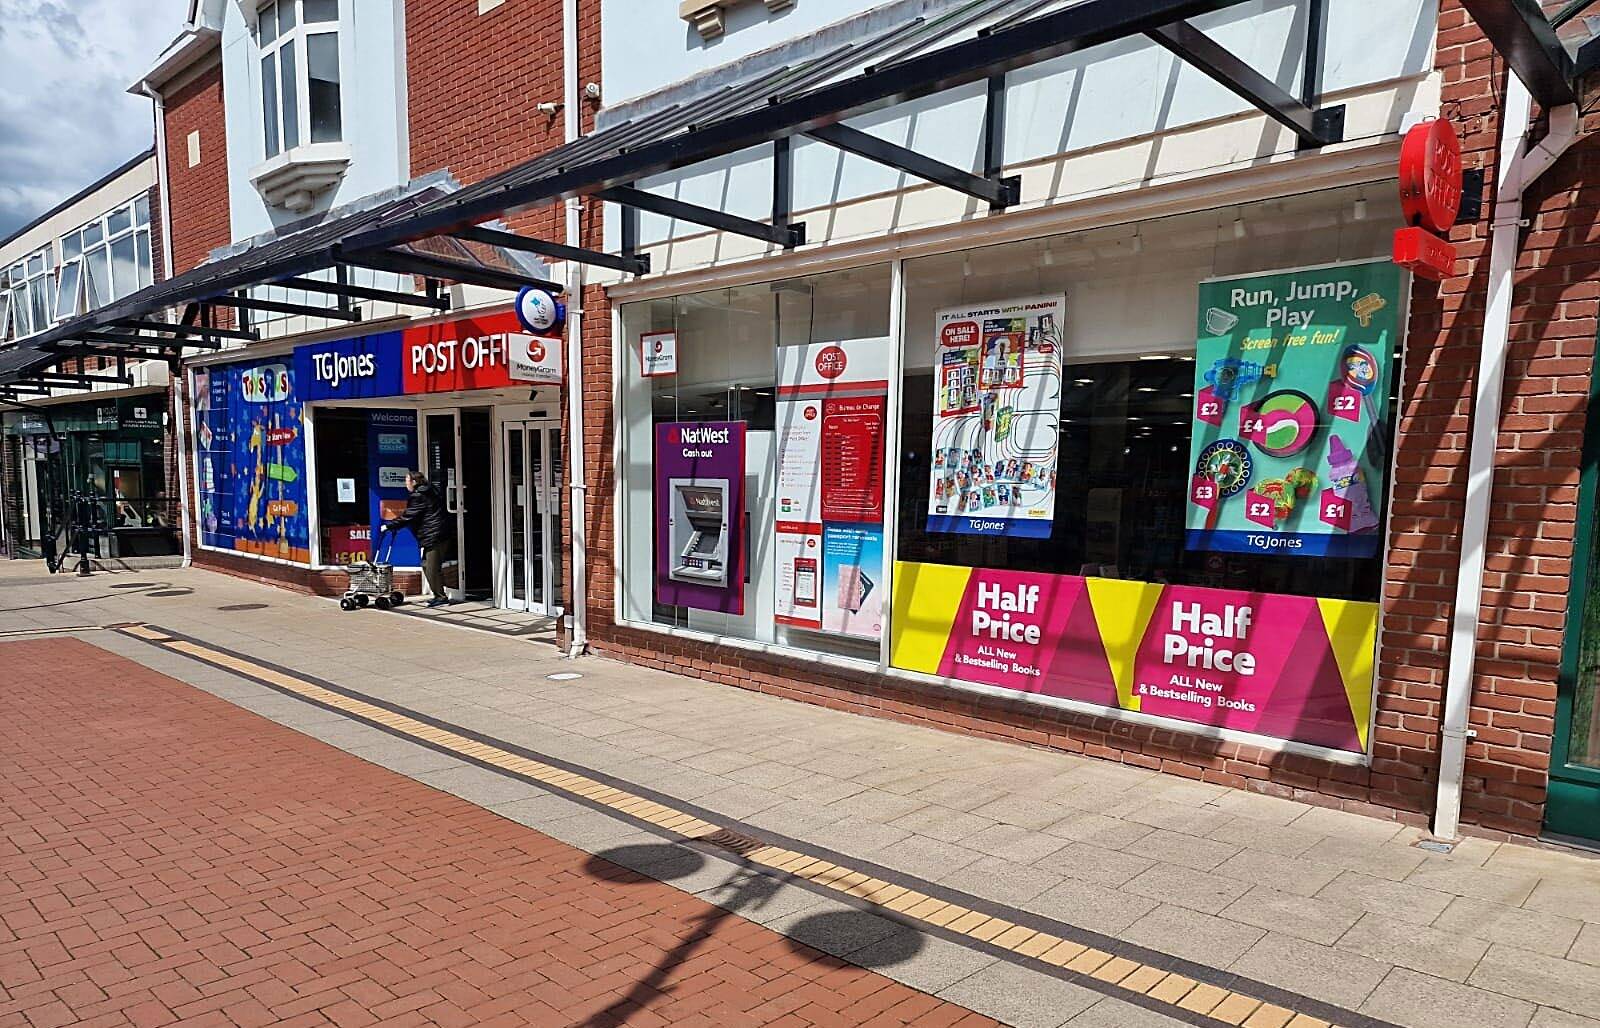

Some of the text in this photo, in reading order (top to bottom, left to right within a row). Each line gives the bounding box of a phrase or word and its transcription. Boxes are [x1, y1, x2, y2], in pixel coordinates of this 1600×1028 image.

[1231, 280, 1358, 307] Run, Jump,
[968, 309, 1000, 317] STARTS
[1266, 306, 1315, 330] Play
[945, 327, 956, 336] ON
[957, 325, 976, 334] SALE
[950, 334, 971, 343] HERE!
[1240, 329, 1340, 350] Screen free fun!
[412, 332, 507, 374] POST OFFI
[822, 352, 841, 362] POST
[312, 352, 374, 387] TGJones
[516, 363, 557, 374] MoneyGram
[818, 362, 844, 371] OFFICE
[862, 403, 880, 411] Change
[1200, 403, 1218, 416] £2
[1333, 396, 1356, 411] £2
[371, 413, 415, 422] Welcome
[1243, 419, 1264, 433] £4
[681, 427, 729, 444] NatWest
[682, 448, 713, 458] Cash out
[1195, 486, 1213, 499] £3
[1249, 503, 1270, 517] £2
[1325, 504, 1345, 518] £1
[969, 520, 1005, 531] TGJones
[350, 529, 372, 540] SALE
[1247, 535, 1302, 549] TGJones
[340, 551, 367, 564] £10
[977, 582, 1040, 614] Half
[1172, 601, 1253, 639] Half
[972, 610, 1041, 645] Price
[977, 645, 1017, 660] ALL New
[1163, 634, 1256, 676] Price
[954, 653, 1041, 677] & Bestselling Books
[1169, 674, 1223, 692] ALL New
[1139, 683, 1256, 712] & Bestselling Books
